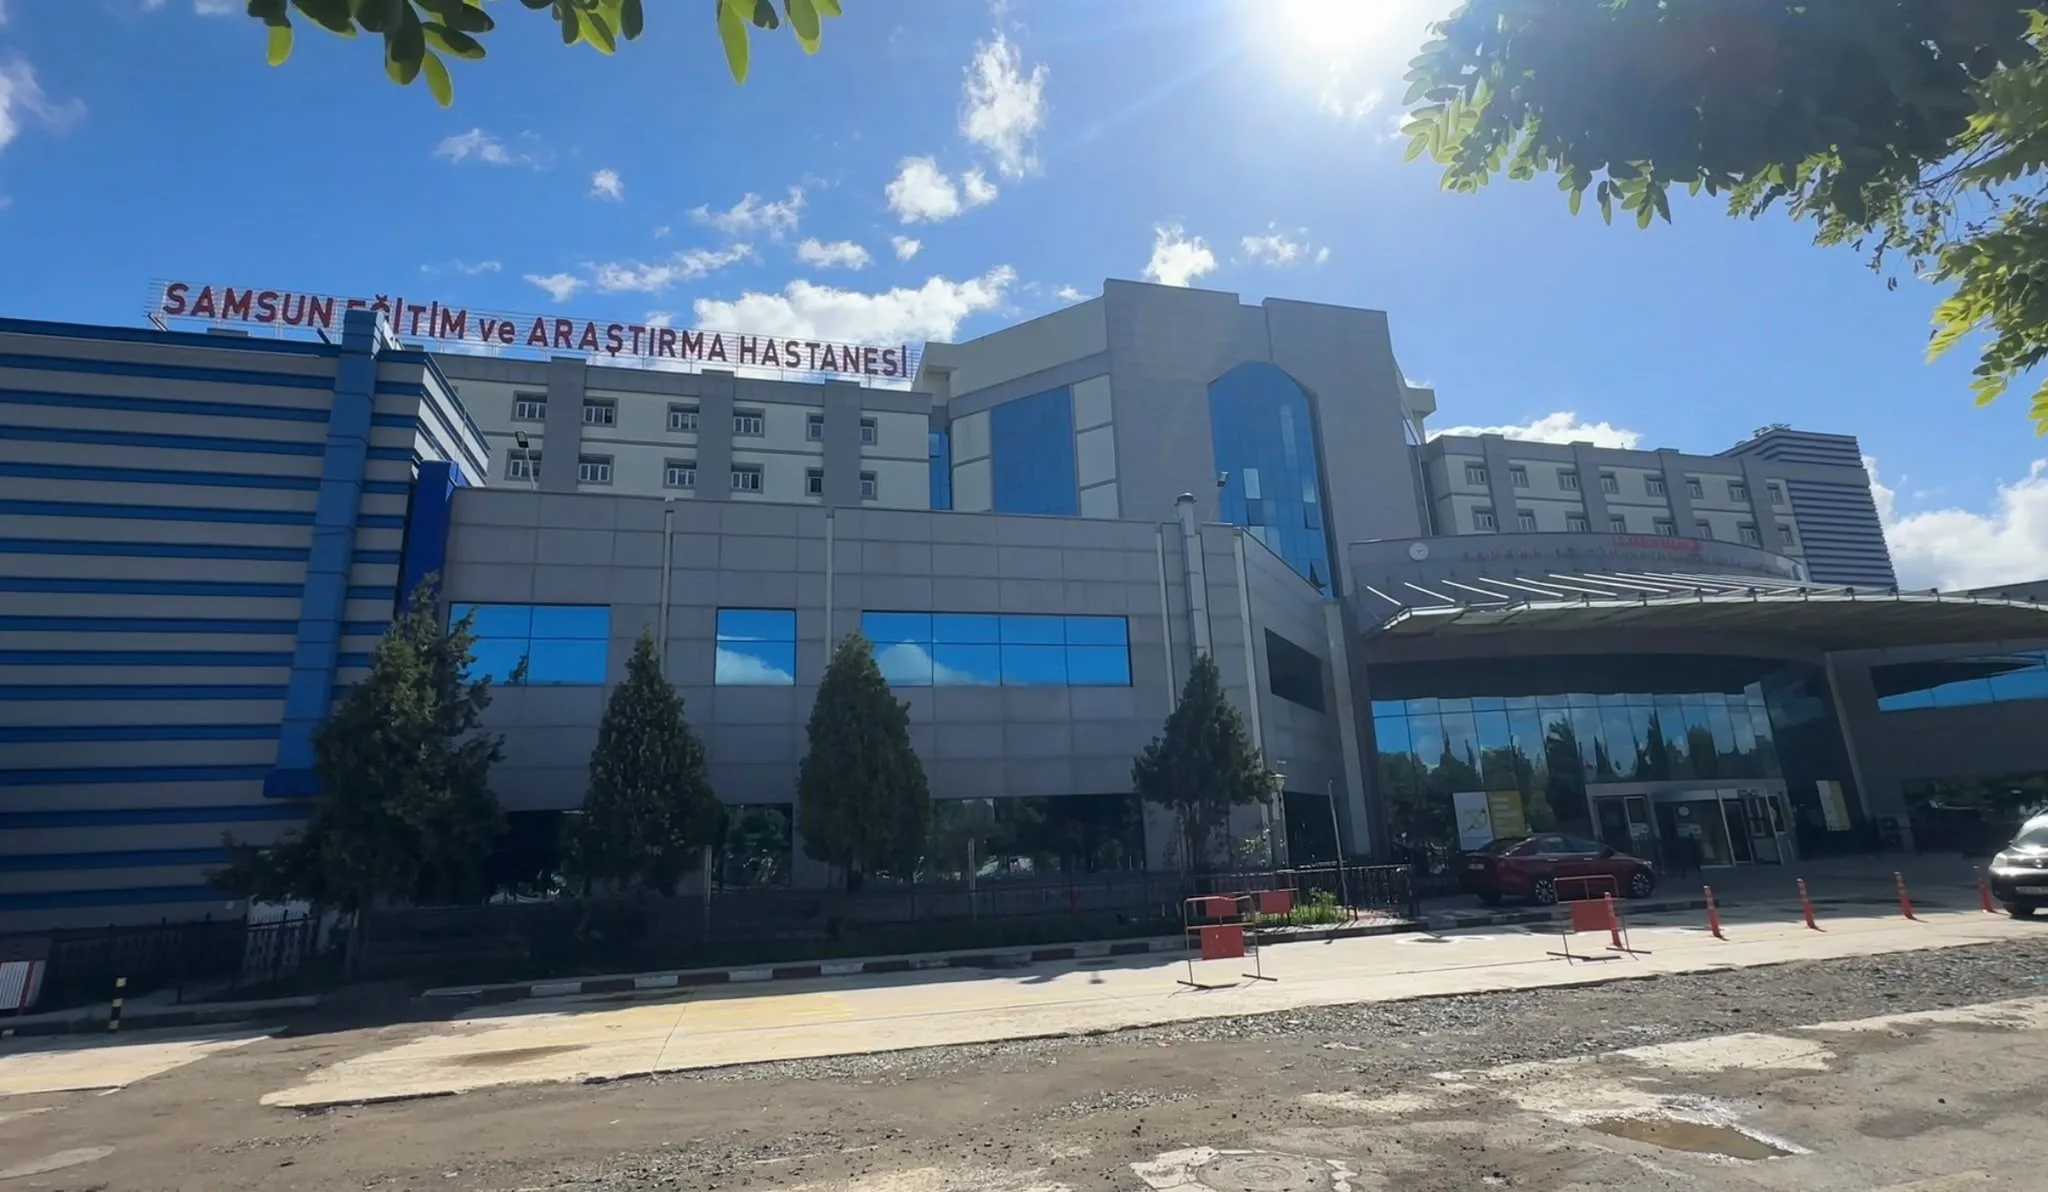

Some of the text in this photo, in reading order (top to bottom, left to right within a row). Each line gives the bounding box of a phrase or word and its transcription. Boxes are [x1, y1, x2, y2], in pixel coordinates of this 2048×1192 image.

[162, 282, 908, 377] SAMSUN İTİM ve ARAŞTIRMA HASTANESİ
